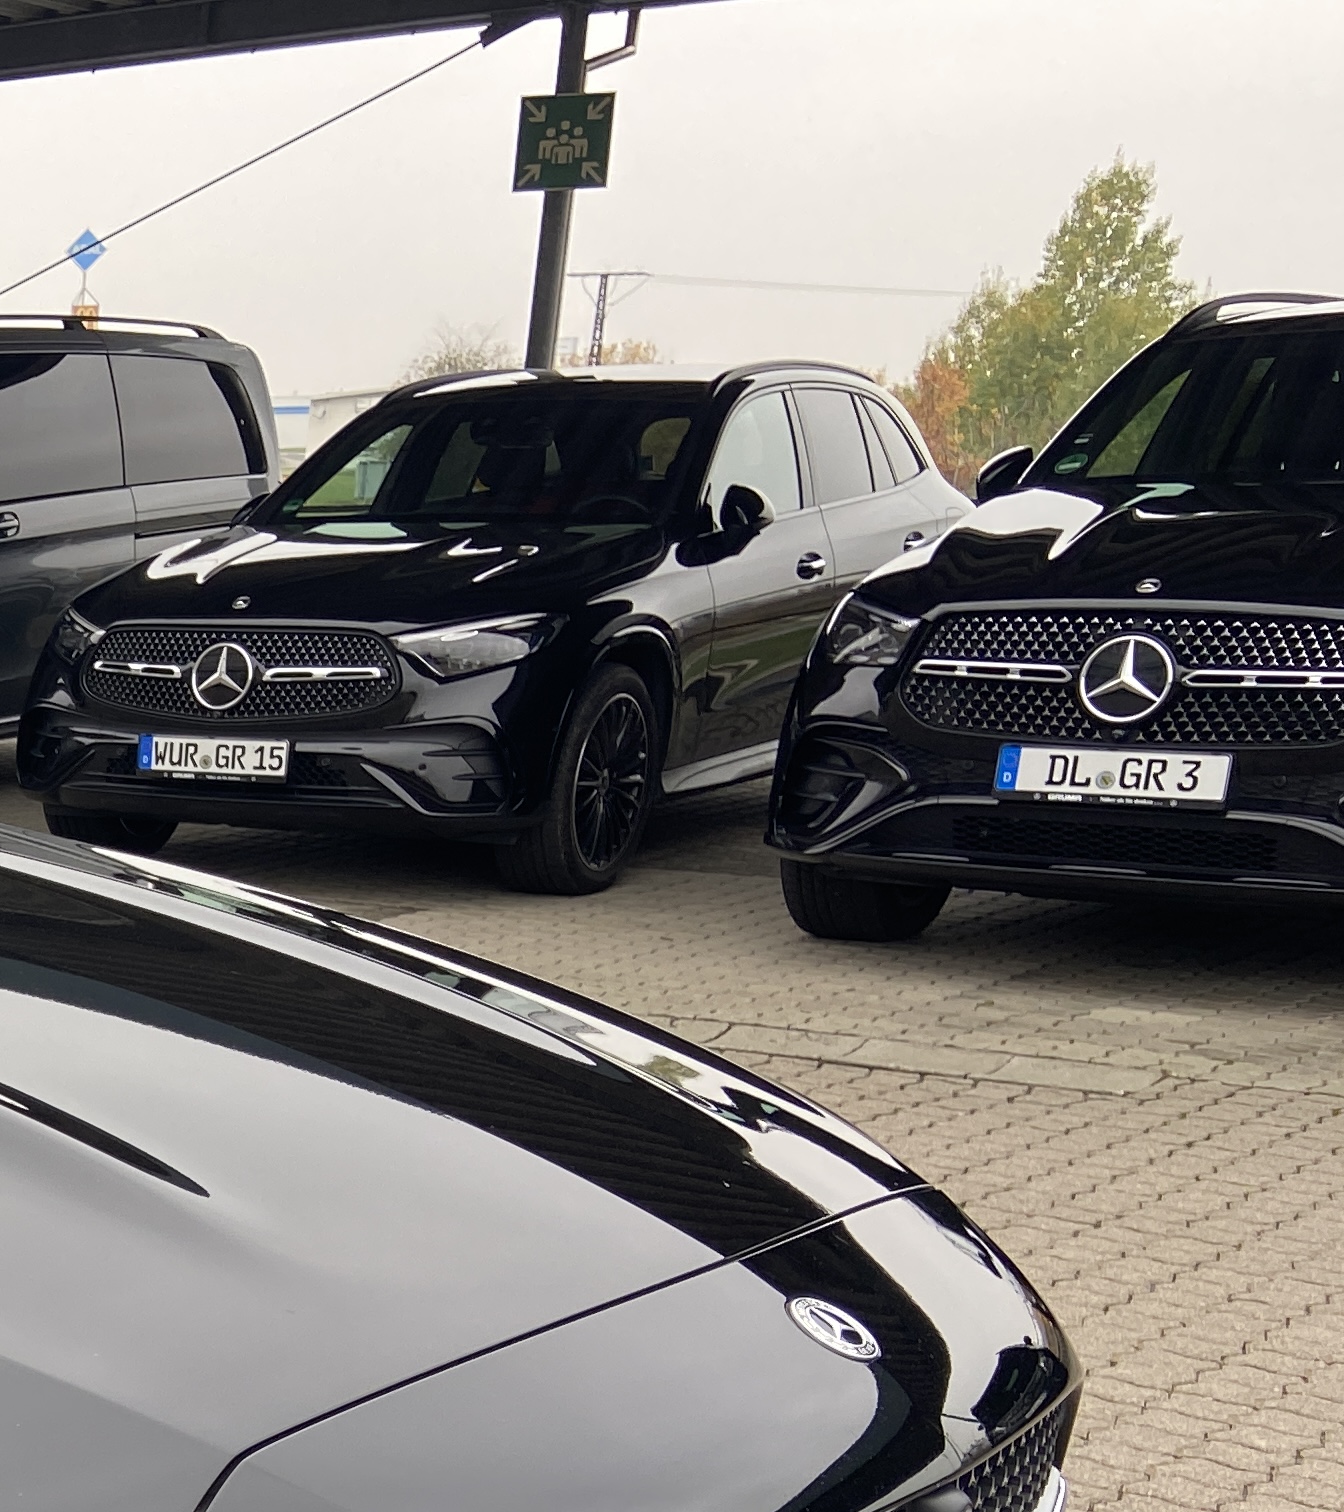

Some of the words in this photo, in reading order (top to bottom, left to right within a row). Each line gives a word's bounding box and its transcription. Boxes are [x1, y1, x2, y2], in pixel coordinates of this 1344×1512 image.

[154, 741, 199, 768] WUR
[215, 744, 246, 770] GR
[252, 745, 285, 771] 15
[1003, 772, 1012, 783] D
[1045, 754, 1091, 787] DL
[1119, 758, 1168, 792] GR
[1177, 760, 1202, 792] 3
